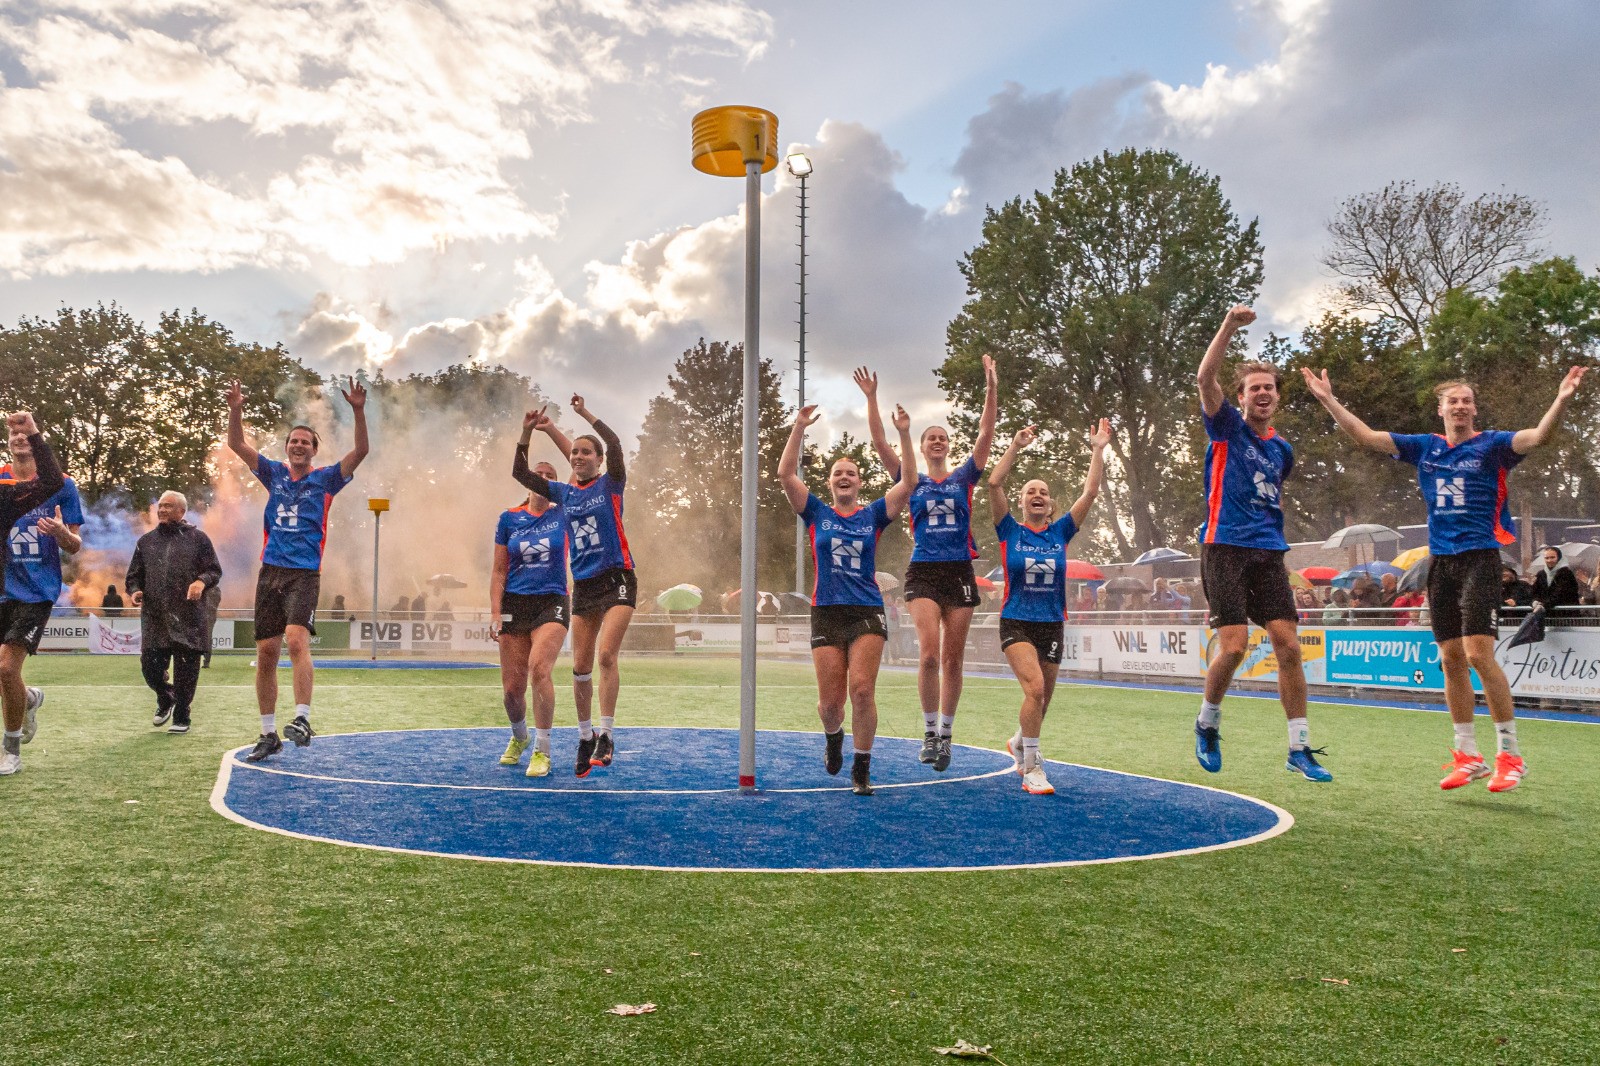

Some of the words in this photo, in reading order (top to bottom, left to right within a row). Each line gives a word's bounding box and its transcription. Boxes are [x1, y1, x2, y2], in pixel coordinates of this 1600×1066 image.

[753, 134, 760, 150] 1
[962, 585, 971, 595] 11
[361, 622, 402, 640] BVB
[412, 623, 452, 641] BVB
[1331, 640, 1422, 663] Maasland
[1122, 661, 1176, 672] GEVELRENOVATIE
[1508, 642, 1600, 688] Hortus
